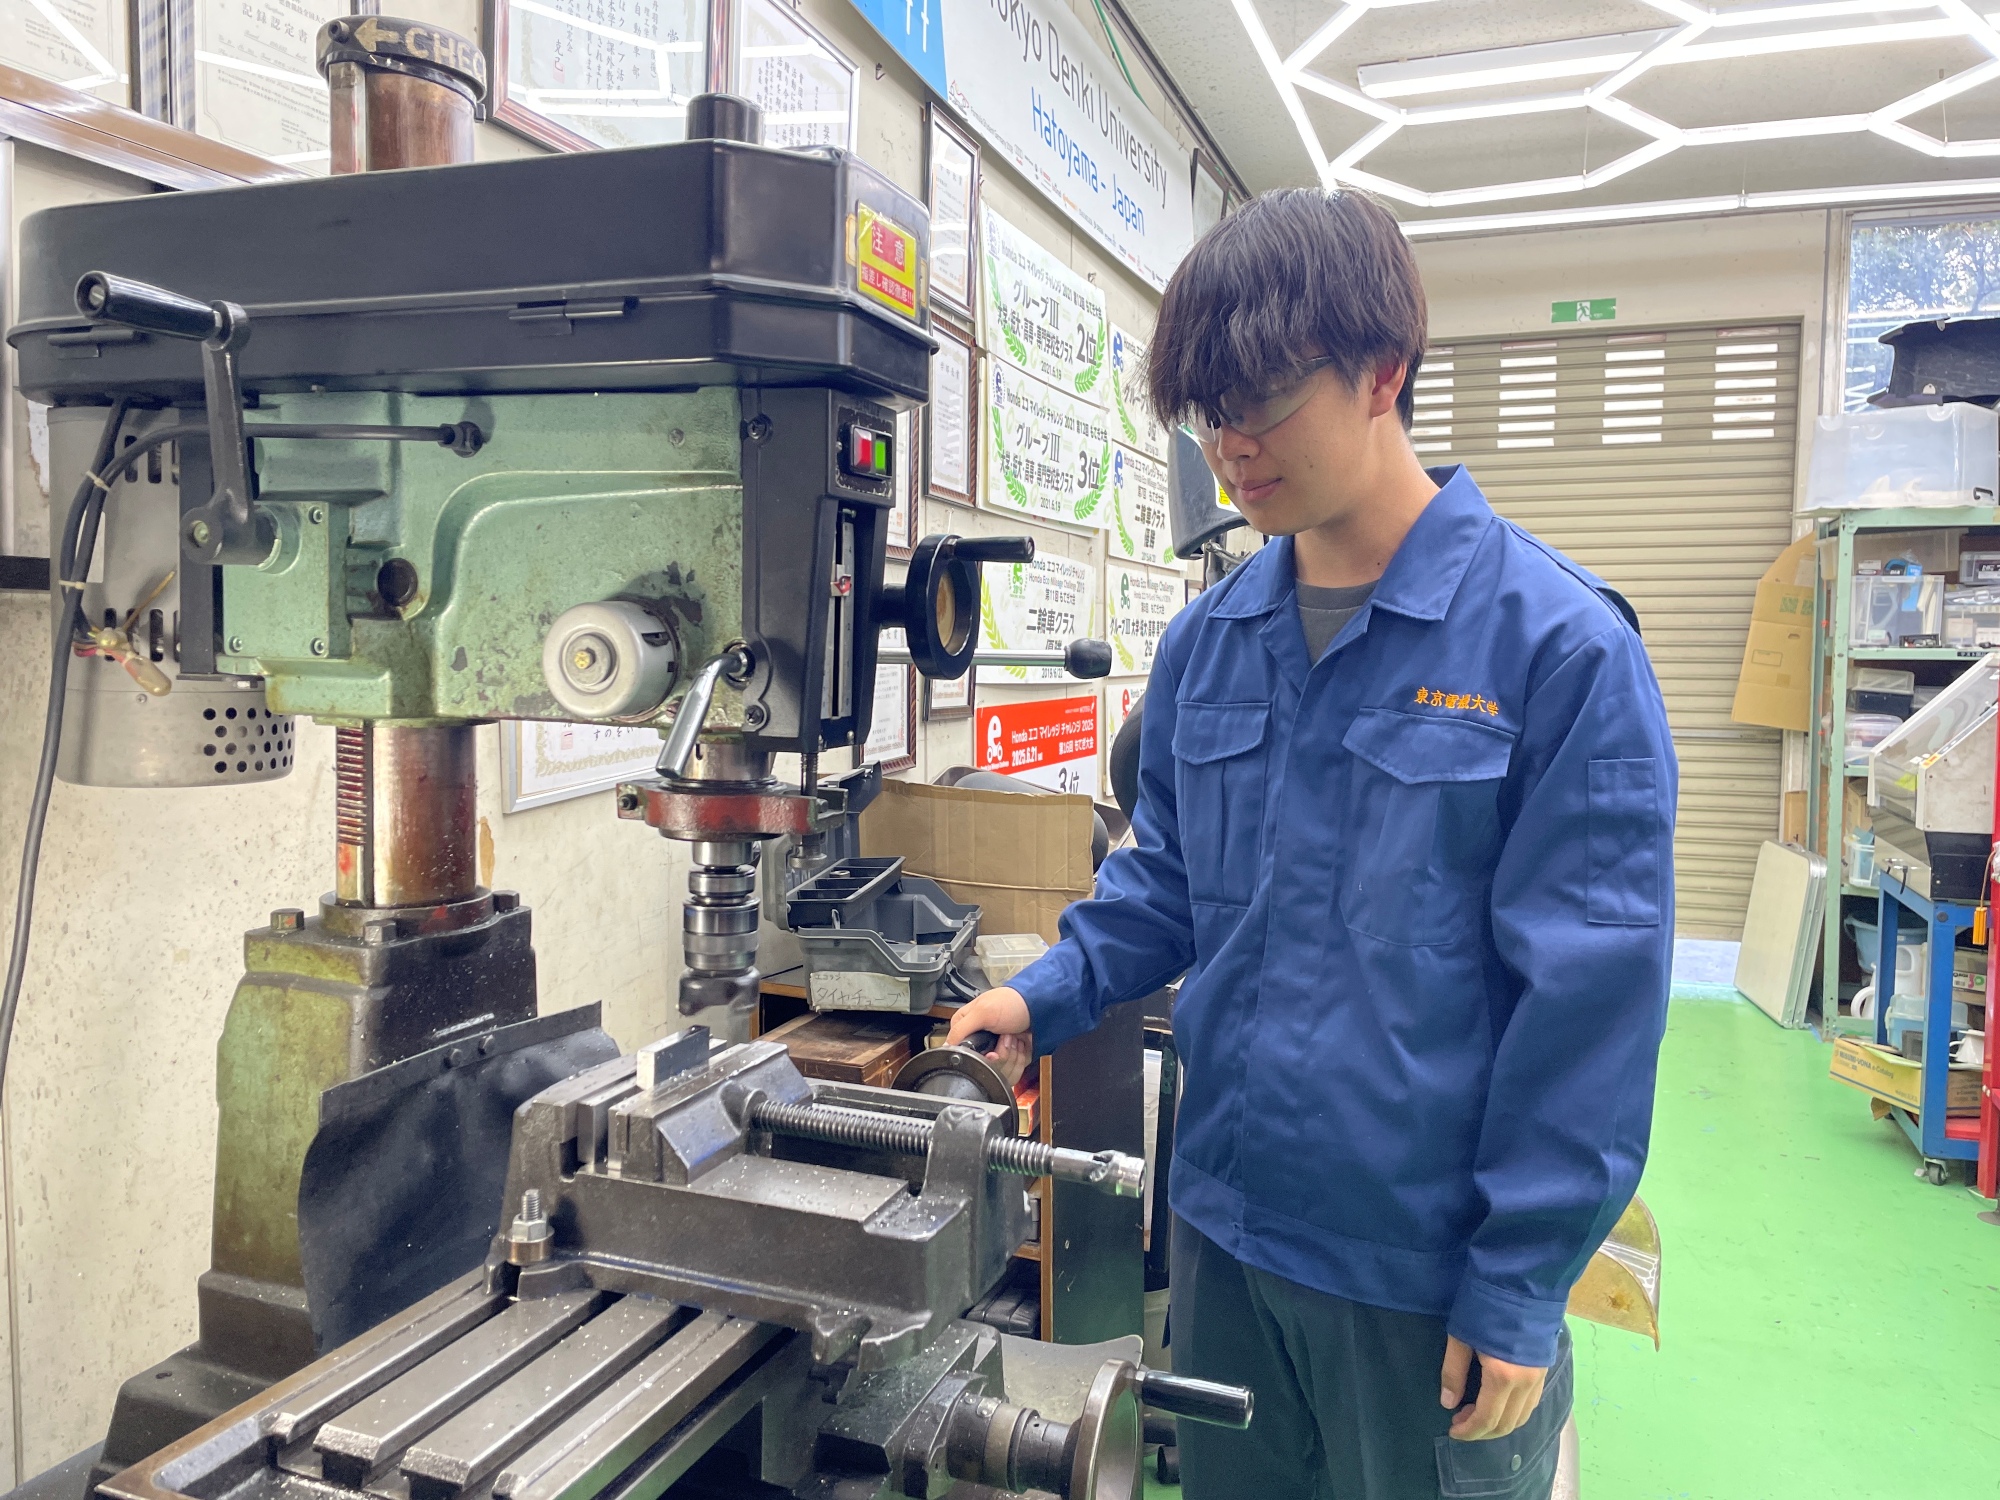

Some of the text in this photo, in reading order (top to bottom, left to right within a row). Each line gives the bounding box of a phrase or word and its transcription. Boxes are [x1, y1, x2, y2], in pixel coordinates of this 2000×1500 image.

[1048, 21, 1094, 124] Denki
[1099, 83, 1167, 209] University
[1031, 86, 1098, 194] Hatoyama
[1112, 173, 1145, 236] Japan
[871, 221, 905, 267] 注意
[1076, 322, 1097, 366] 2位
[1077, 449, 1100, 490] 3位
[1028, 572, 1043, 584] Honda
[1026, 607, 1075, 635] 二輪車クラス
[1414, 686, 1500, 717] 東京電機大学
[1011, 718, 1095, 744] Honda エコ マイレッジ チャレンジ 2025
[1011, 746, 1038, 768] 2025.6.21
[1058, 739, 1074, 756] 第16回
[1074, 735, 1095, 752] もてぎ大会
[1058, 767, 1081, 794] 3位
[816, 986, 906, 1008] タイヤチューブ
